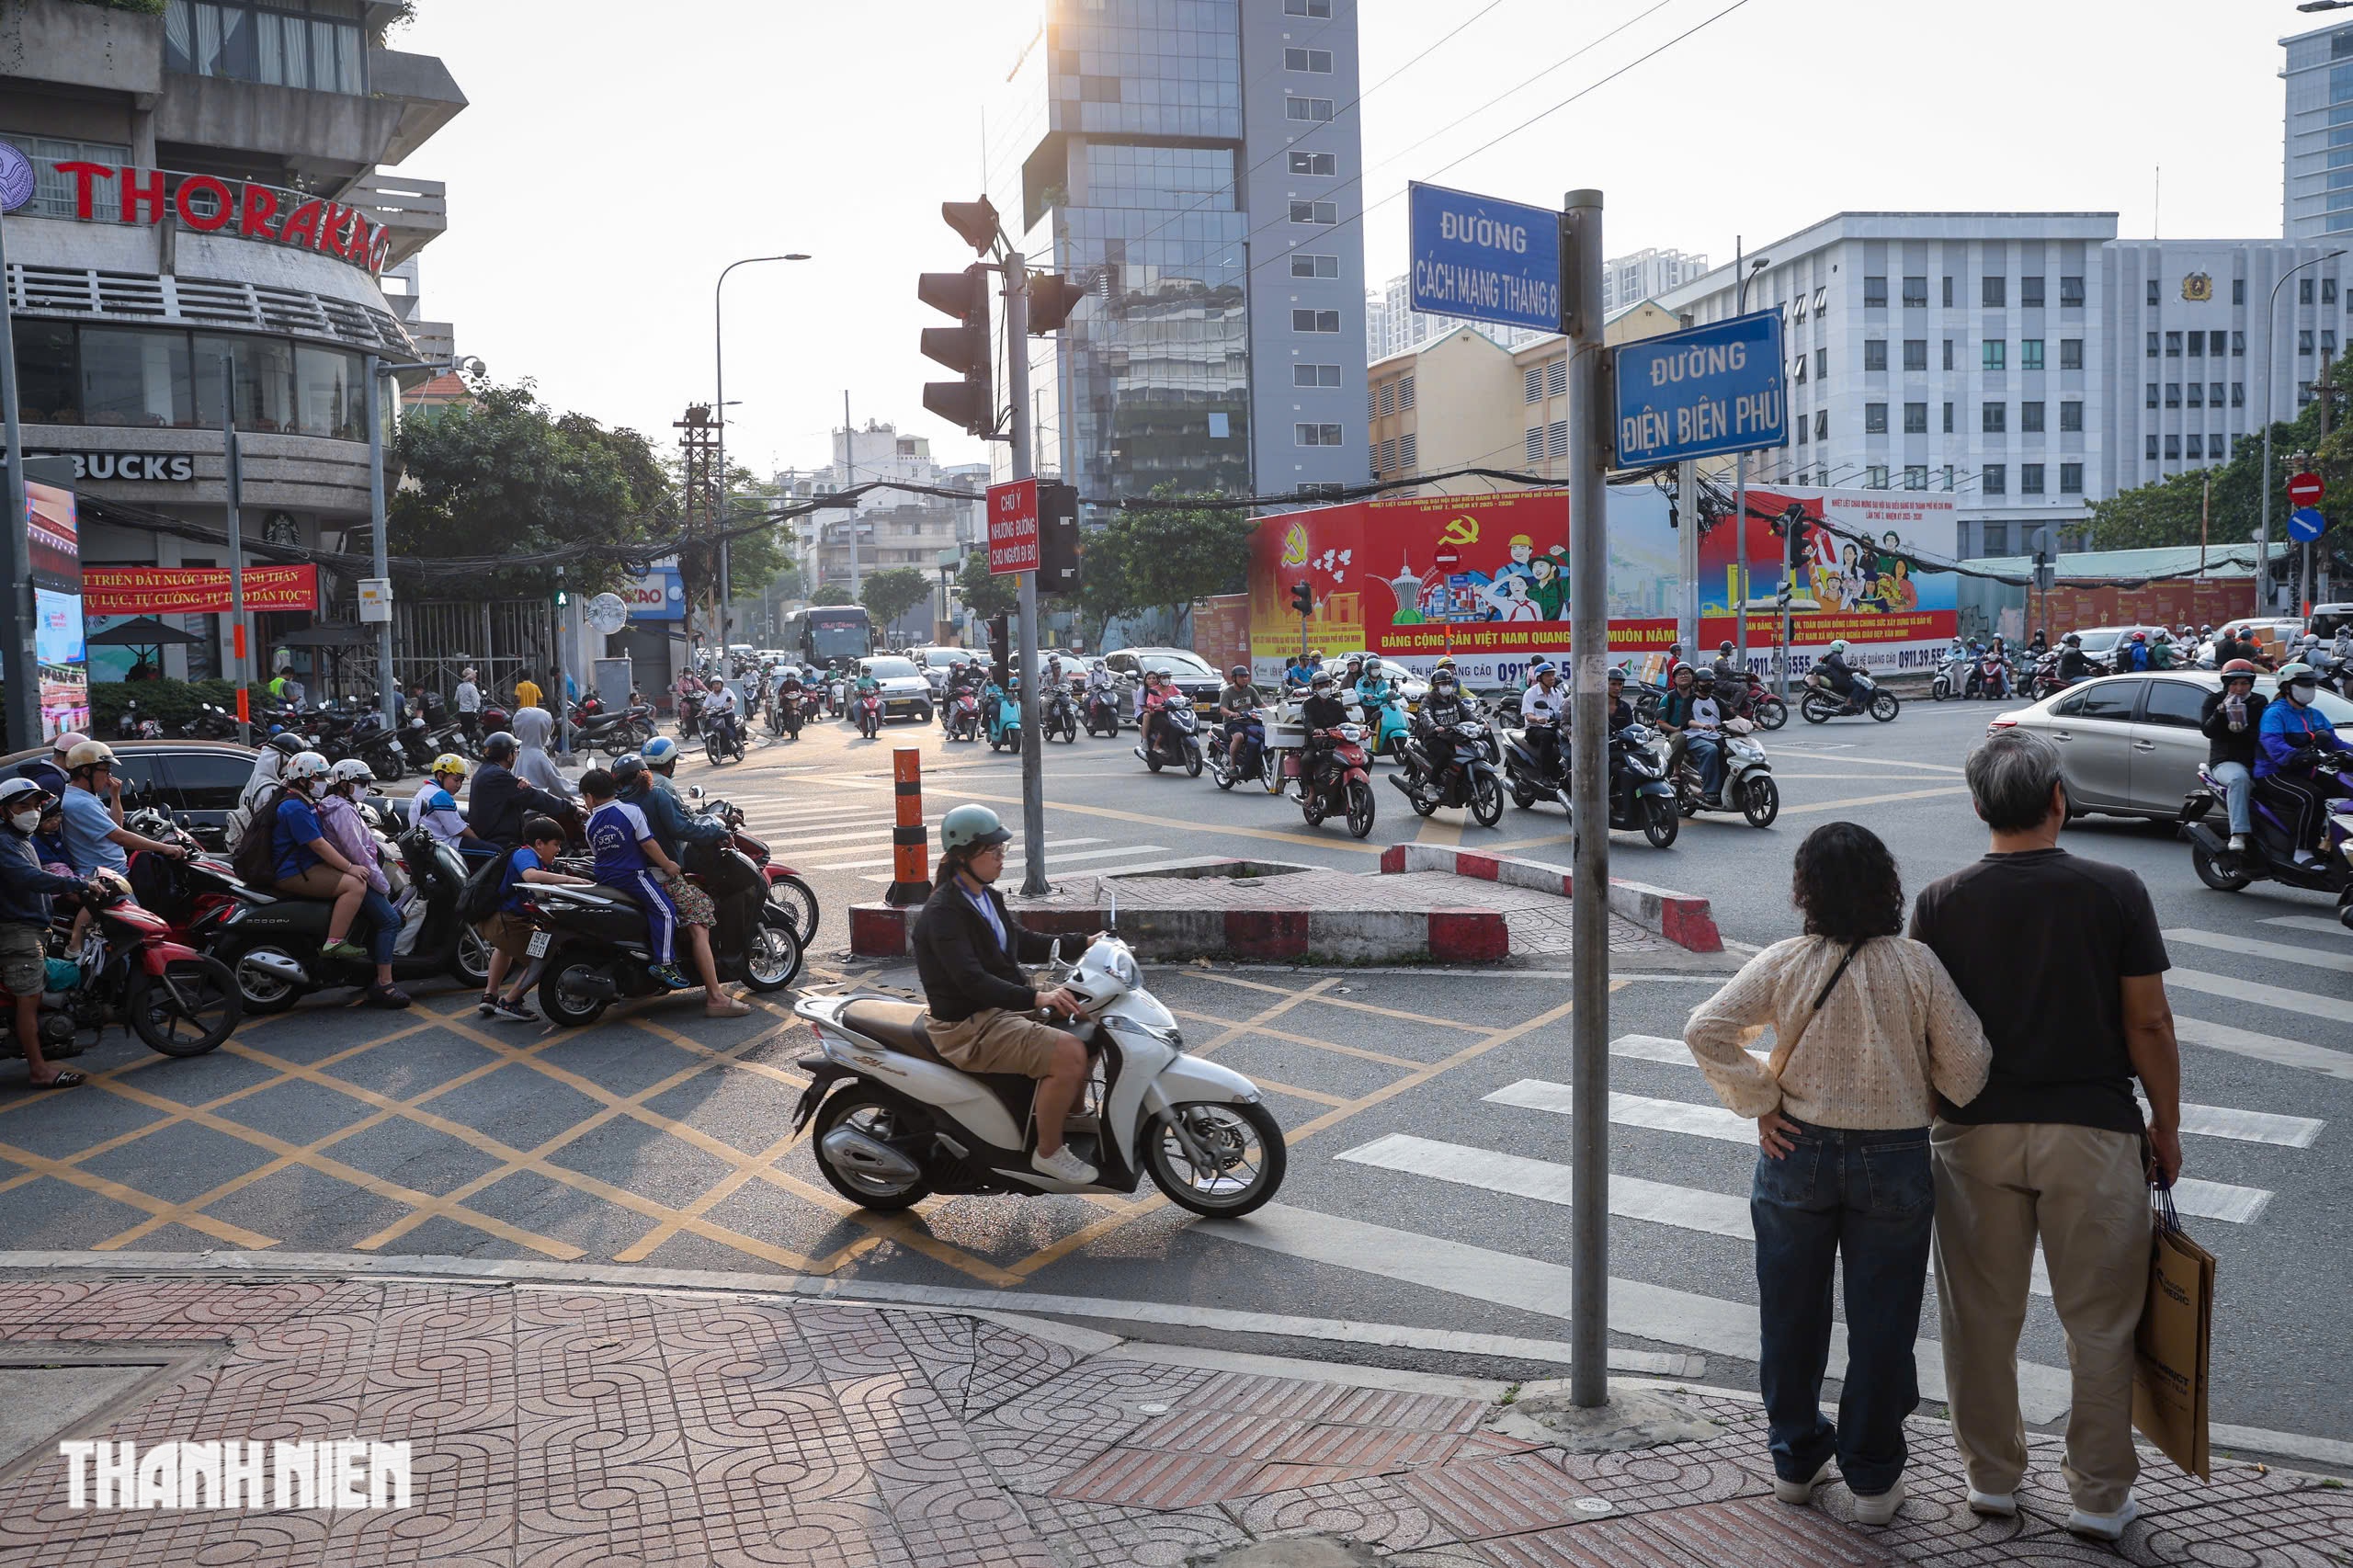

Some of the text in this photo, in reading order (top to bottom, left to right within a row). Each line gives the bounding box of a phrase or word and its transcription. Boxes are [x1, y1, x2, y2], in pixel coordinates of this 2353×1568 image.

[53, 161, 390, 276] THORAKAO
[1440, 209, 1528, 254] ĐƯỜNG
[1415, 250, 1557, 319] CÁCH MẠNG THÁNG 8
[1650, 340, 1745, 387] ĐƯỜNG
[1621, 377, 1780, 456] ĐIỆN BIÊN PHỦ
[72, 454, 193, 481] BUCKS
[1017, 487, 1021, 509] Ý
[993, 549, 1003, 566] CHO
[1028, 540, 1036, 564] BỘ
[165, 572, 199, 585] NƯỚC
[136, 593, 153, 608] TỰ
[206, 591, 223, 606] TỰ
[224, 591, 250, 603] HO
[253, 588, 277, 602] DÂN
[1381, 632, 1411, 648] ĐẢNG
[1415, 633, 1445, 649] CỘNG
[1449, 630, 1471, 646] SẢN
[1474, 631, 1498, 647] VIỆT
[1502, 632, 1528, 644] NAM
[1531, 631, 1571, 644] QUANG
[1608, 627, 1643, 642] MUÔN
